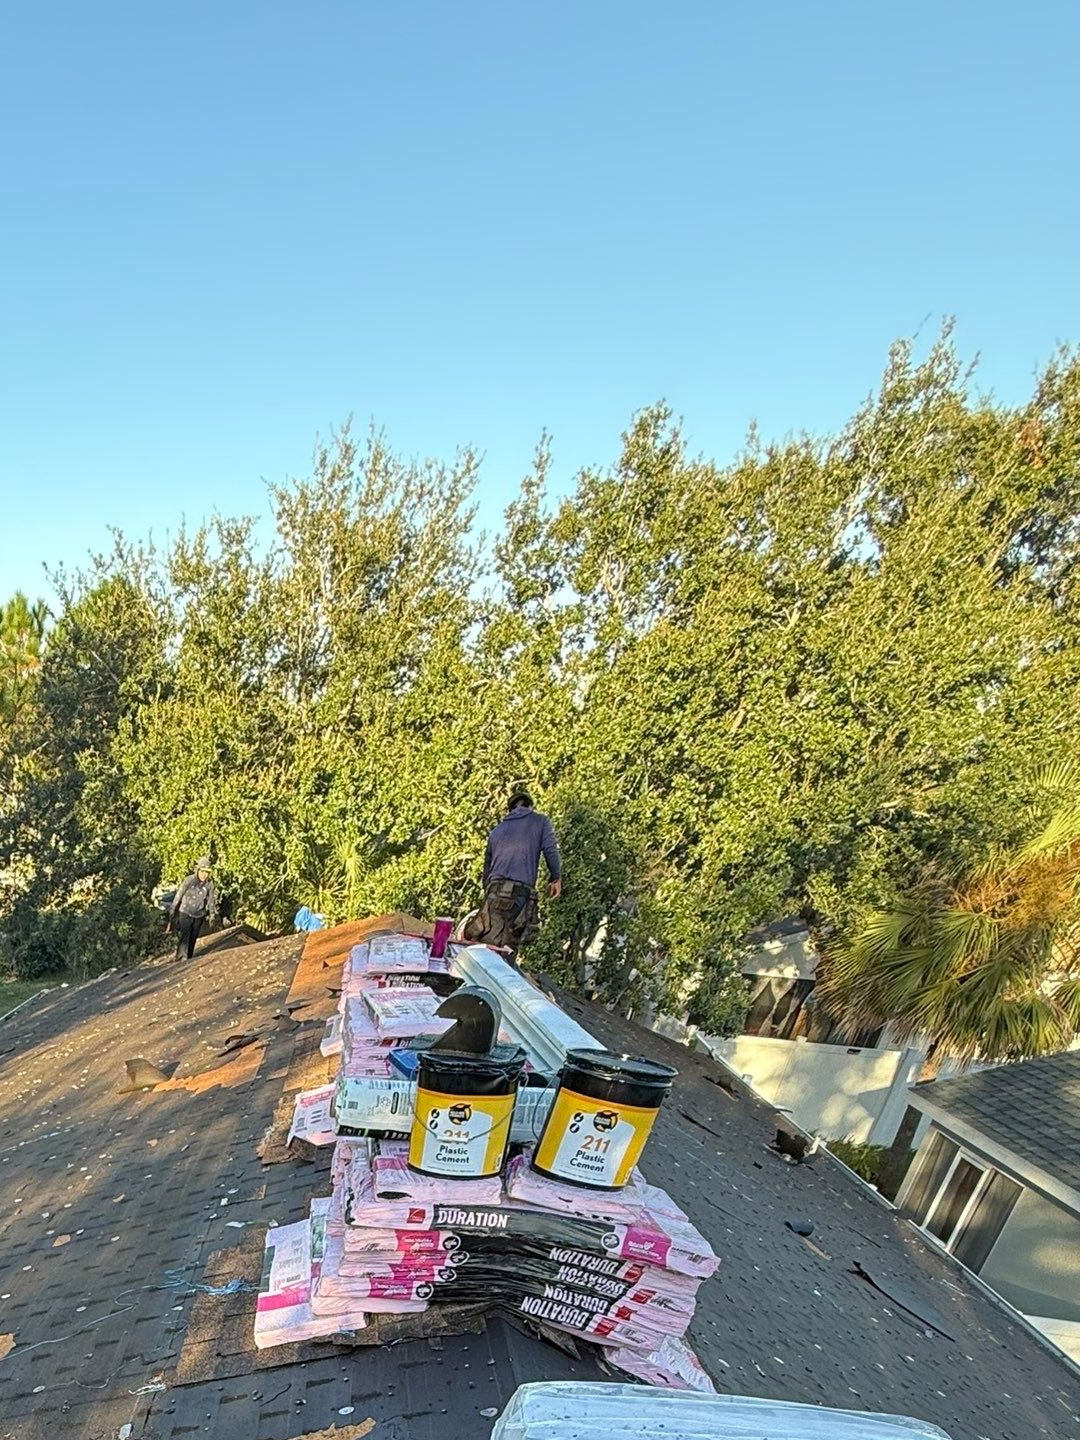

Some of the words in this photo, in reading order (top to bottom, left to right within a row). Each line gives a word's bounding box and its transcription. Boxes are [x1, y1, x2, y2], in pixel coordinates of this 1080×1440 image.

[440, 1145, 468, 1155] Plastic
[581, 1135, 612, 1153] 211
[436, 1153, 470, 1163] Cement
[570, 1157, 605, 1172] Cement
[575, 1150, 606, 1163] Plastic
[436, 1208, 509, 1228] DURATION
[549, 1248, 619, 1273] DURATION
[544, 1284, 608, 1313] DURATION
[520, 1296, 590, 1328] DURATION
